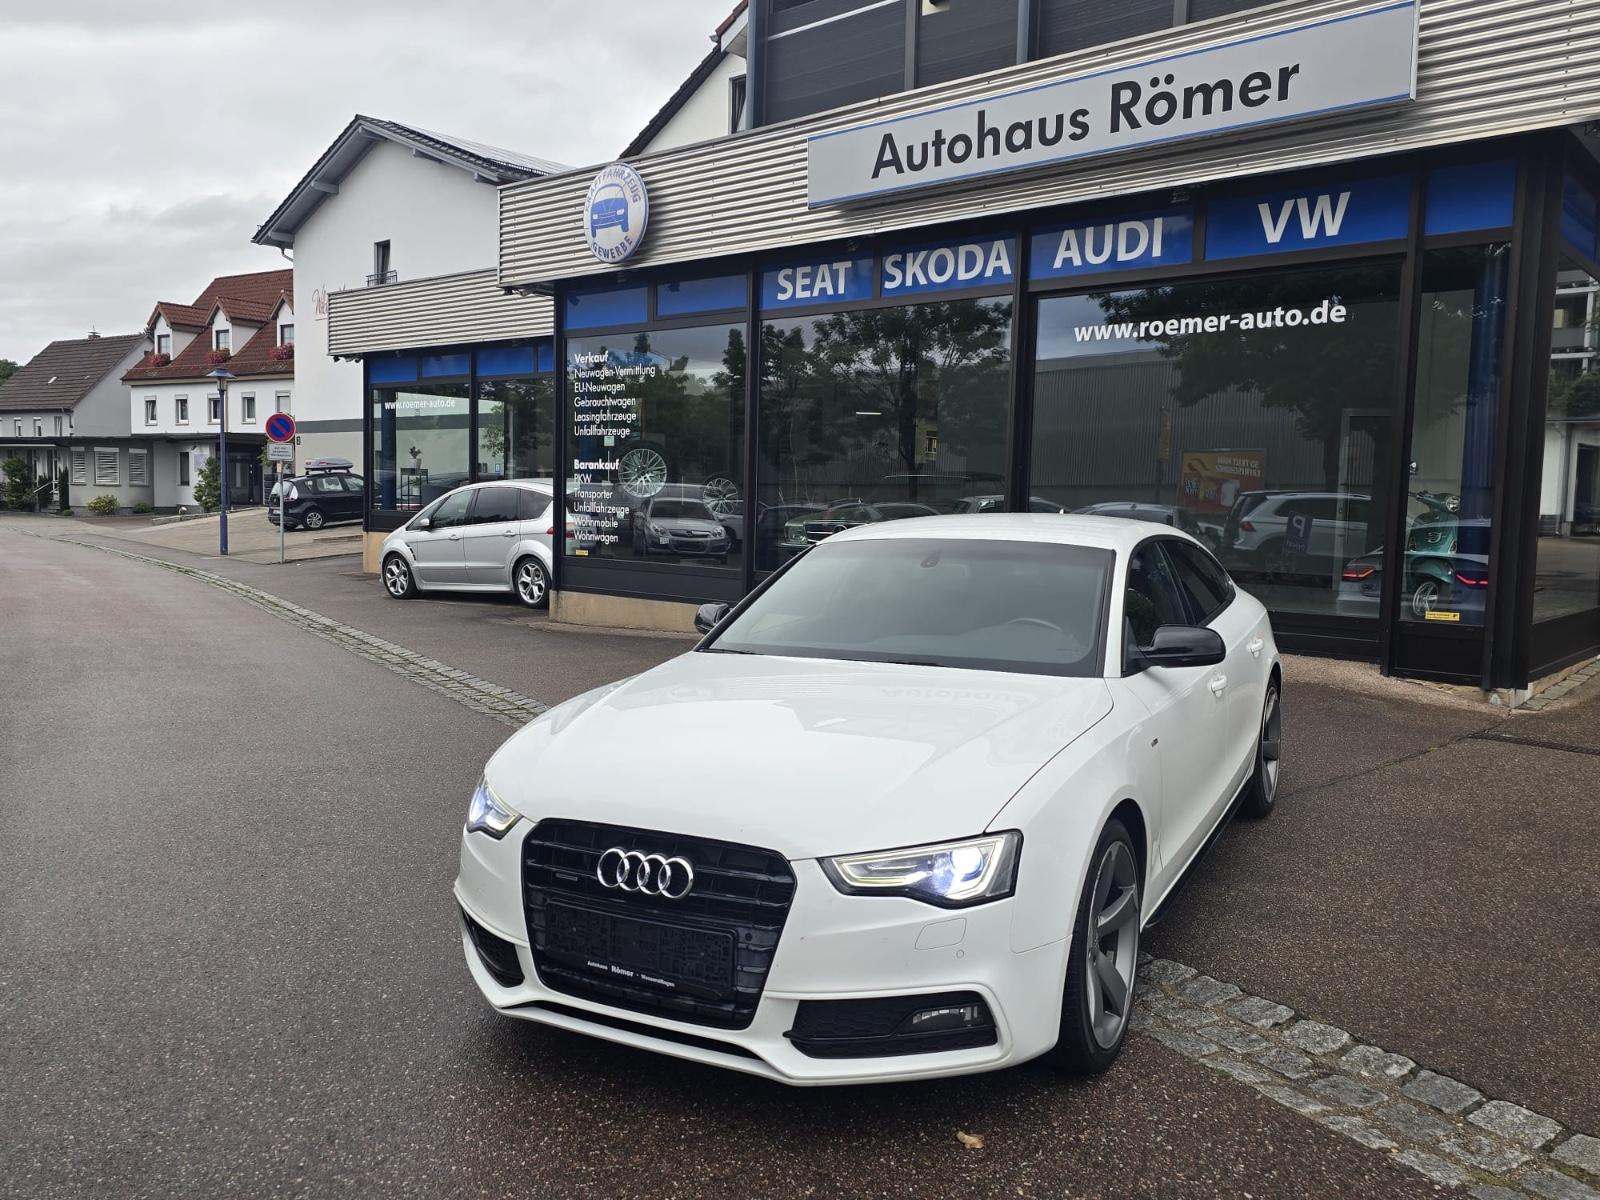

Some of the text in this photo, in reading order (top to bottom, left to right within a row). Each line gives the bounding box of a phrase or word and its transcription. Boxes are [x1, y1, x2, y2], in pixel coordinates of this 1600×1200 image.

[871, 61, 1300, 179] Autohaus Römer
[1257, 191, 1351, 244] VW
[592, 235, 633, 259] GEWERBE
[1052, 216, 1164, 269] AUDI
[883, 239, 1012, 289] SKODA
[777, 260, 852, 300] SEAT
[1073, 299, 1348, 343] www.roemer-auto.de
[574, 350, 609, 364] Verkauf
[574, 363, 656, 380] Neuwagen-Vermittlung
[574, 382, 626, 394] EU-Neuwagen
[384, 399, 456, 410] www.roemer-auto.de
[574, 395, 636, 409] Gebrauchtwagen
[574, 409, 637, 424] Leasingfahrzeuge
[574, 424, 631, 439] Unfallfahrzeuge
[573, 458, 620, 470] Barankauf
[574, 473, 592, 485] PKW
[574, 489, 613, 502] Transporter
[573, 501, 630, 518] Unfallfahrzeuge
[574, 516, 619, 529] Wohnmobile
[573, 529, 619, 544] Wohnwagen
